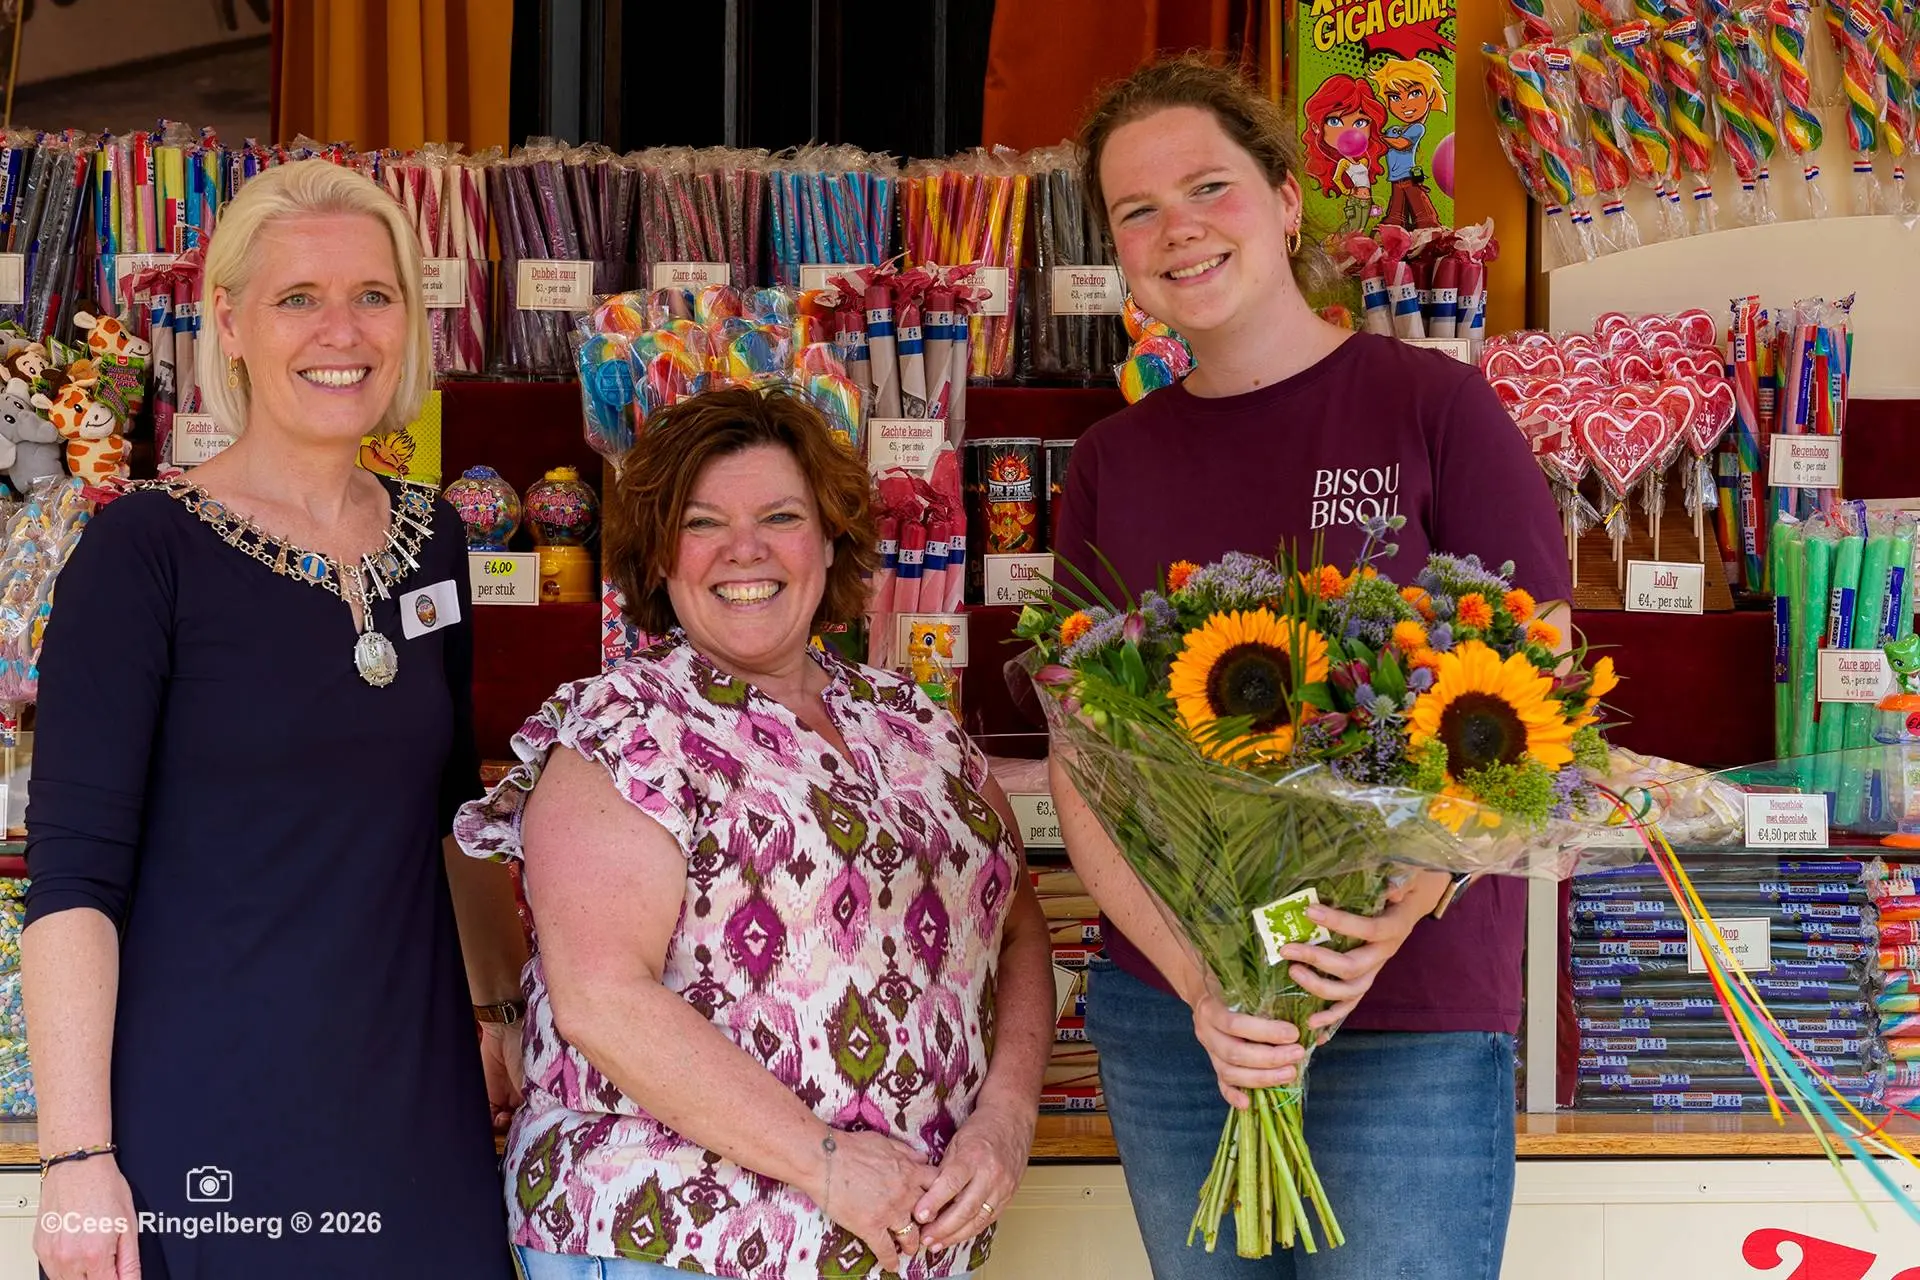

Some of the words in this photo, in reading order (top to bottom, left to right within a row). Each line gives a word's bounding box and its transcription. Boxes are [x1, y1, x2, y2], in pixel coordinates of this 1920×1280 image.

[1313, 0, 1386, 52] GIGA
[1387, 0, 1448, 29] GUM!
[423, 263, 440, 278] dbei
[531, 267, 558, 280] Dubbel
[559, 270, 577, 280] zuur
[672, 269, 689, 281] Zure
[691, 268, 707, 281] cola
[430, 281, 443, 290] stuk
[1071, 274, 1106, 288] Trekdrop
[548, 285, 558, 294] per
[559, 284, 572, 293] stuk
[1084, 291, 1093, 300] per
[1094, 289, 1107, 298] stuk
[1444, 346, 1459, 357] neel
[186, 421, 212, 433] Zachte
[881, 425, 906, 437] Zachte
[908, 426, 933, 438] kaneel
[207, 440, 217, 449] per
[902, 443, 912, 452] per
[913, 442, 925, 450] stuk
[1791, 444, 1829, 459] Regenboog
[1806, 462, 1815, 472] per
[1313, 463, 1399, 497] BISOU
[988, 484, 1004, 498] DR
[1005, 482, 1032, 498] FIRE
[1310, 495, 1398, 529] BISOU
[1010, 563, 1040, 580] Chips
[1654, 571, 1678, 589] Lolly
[478, 586, 493, 597] per
[495, 583, 515, 596] stuk
[997, 587, 1015, 602] €4,-
[1638, 593, 1656, 608] €4,-
[1658, 597, 1672, 610] per
[1674, 596, 1693, 609] stuk
[1839, 658, 1858, 670] Zure
[1860, 659, 1881, 672] appel
[1855, 677, 1865, 687] per
[1865, 676, 1879, 685] stuk
[1766, 815, 1778, 824] met
[1779, 813, 1808, 824] chocolade
[1030, 825, 1046, 840] per
[1048, 822, 1062, 838] stu
[1758, 828, 1782, 842] €4,50
[1783, 830, 1798, 843] per
[1799, 829, 1817, 841] stuk
[1719, 927, 1739, 941] Drop
[1735, 944, 1749, 953] stuk
